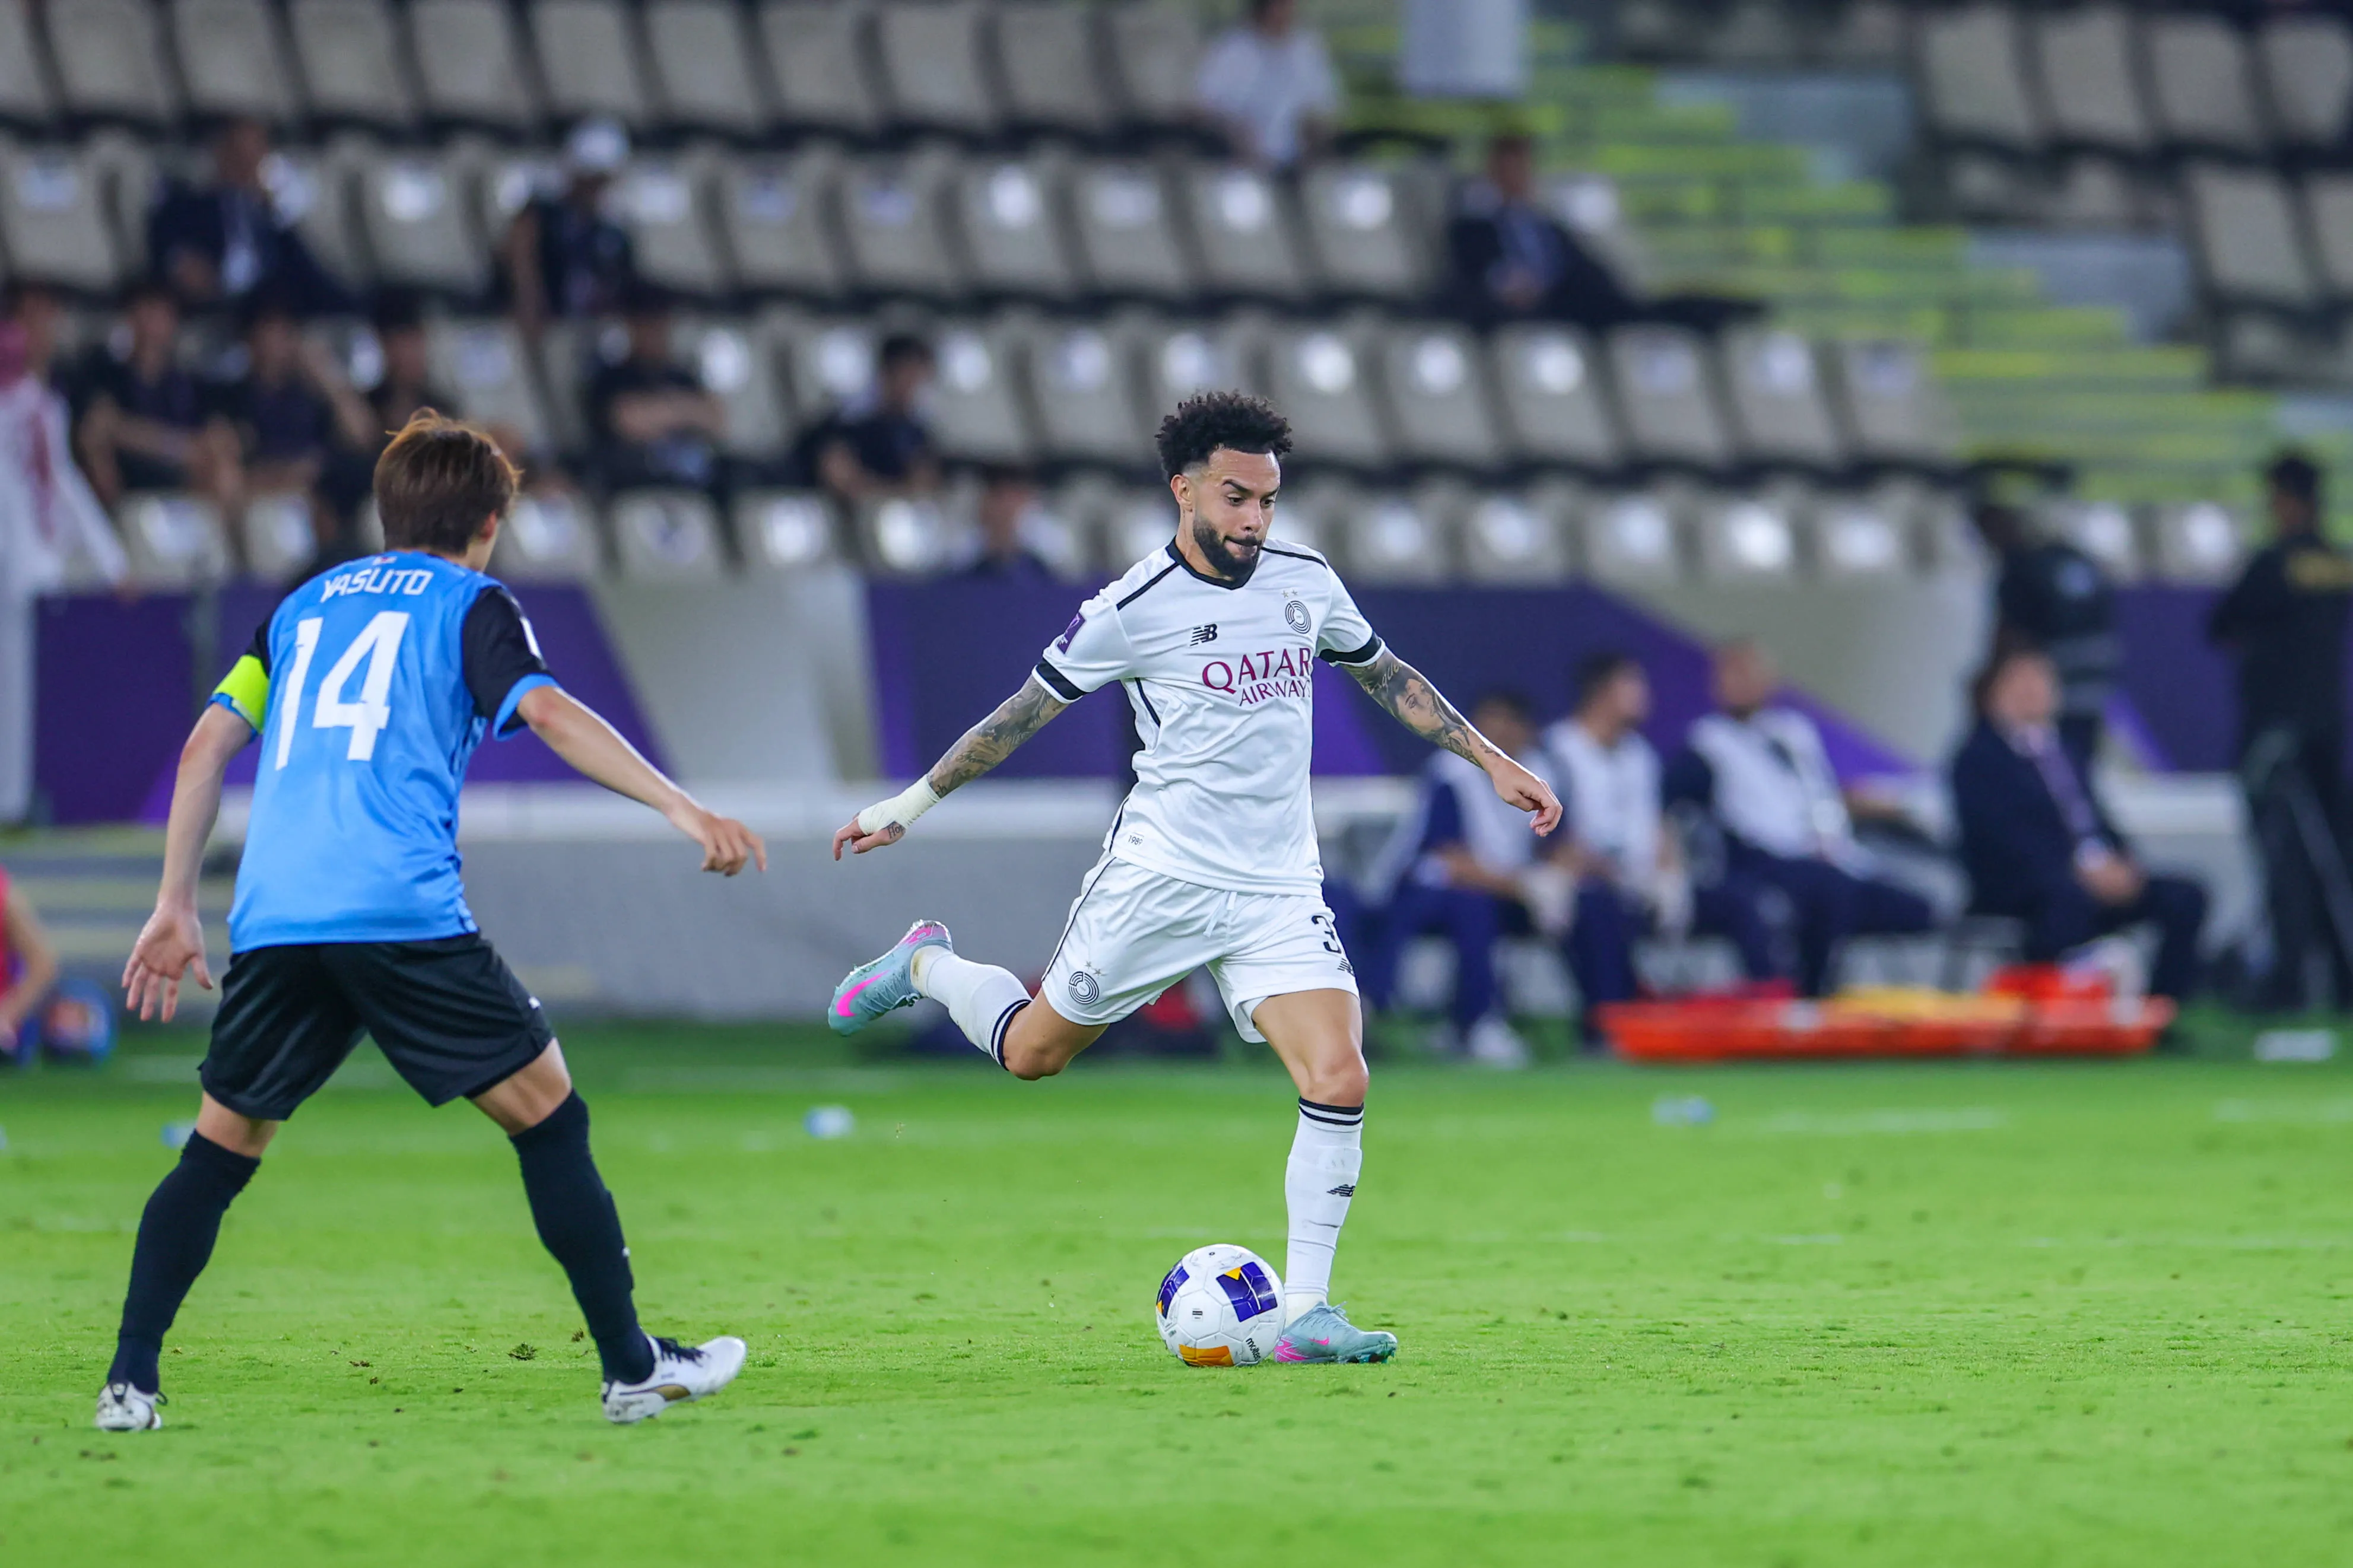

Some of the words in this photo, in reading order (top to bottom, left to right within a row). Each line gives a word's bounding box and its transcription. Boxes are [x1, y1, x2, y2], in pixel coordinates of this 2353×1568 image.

[319, 568, 434, 603] YASUTO
[275, 610, 409, 771] 14
[1202, 647, 1310, 694] QATAR
